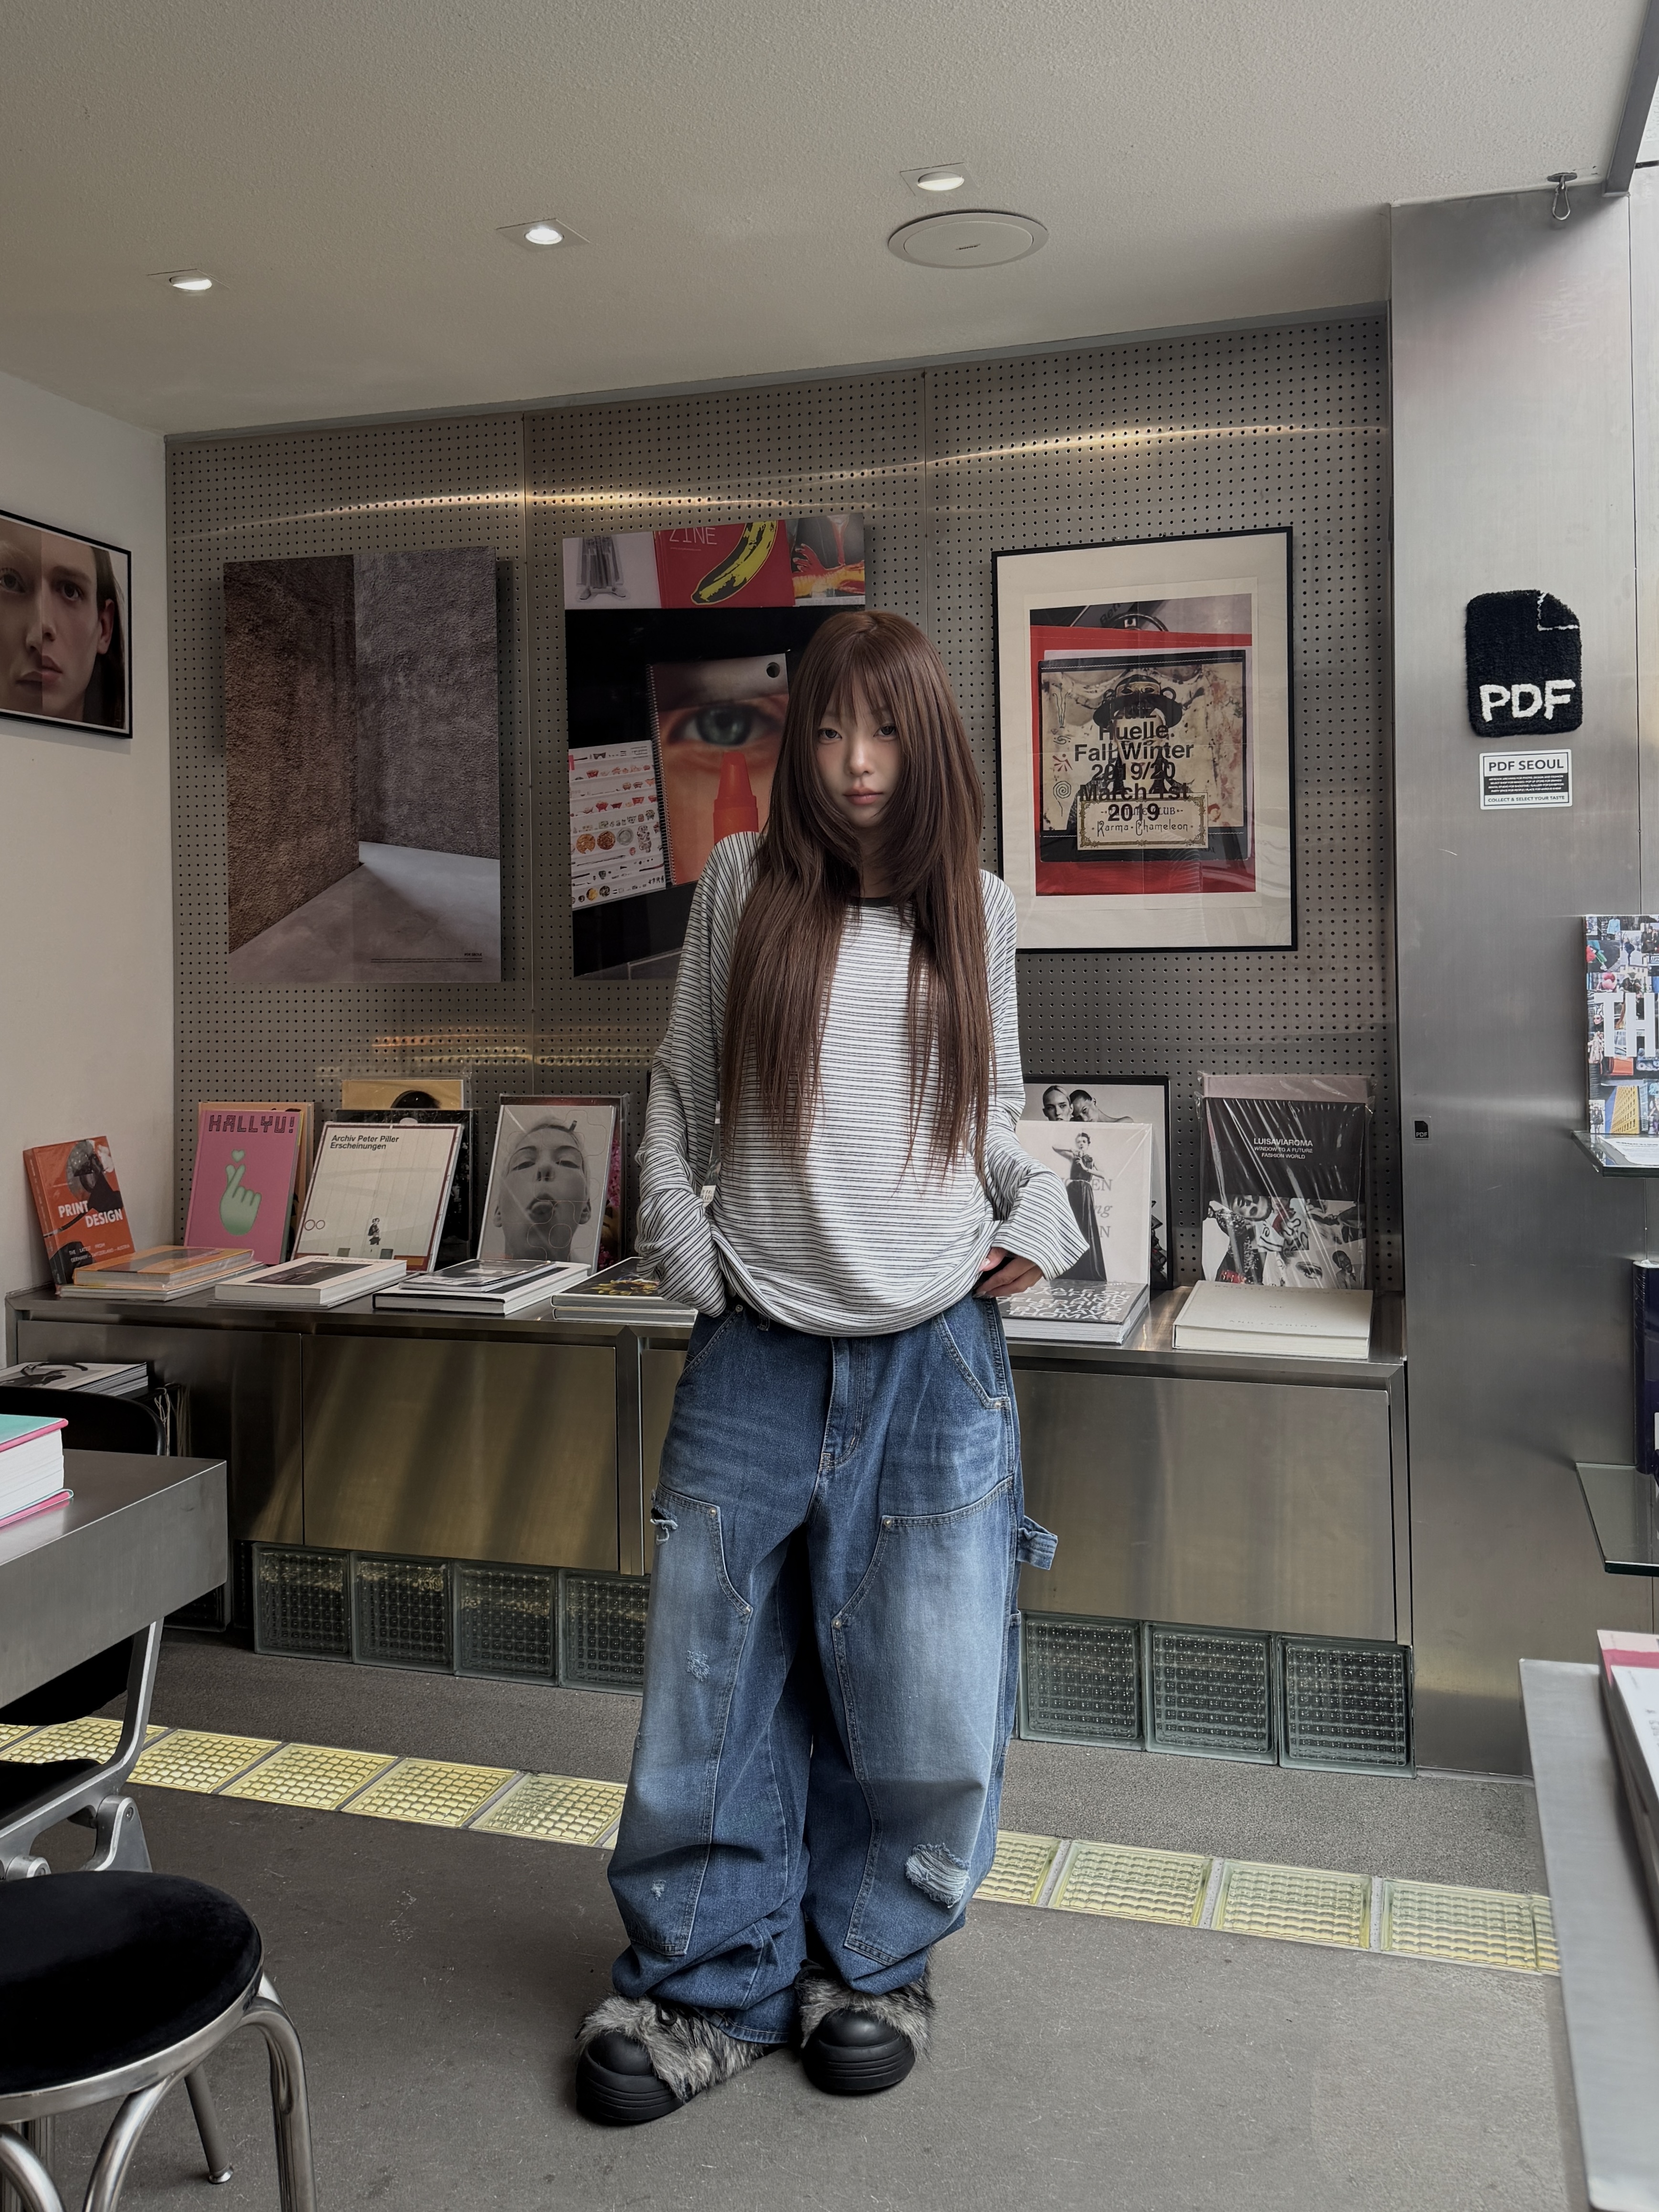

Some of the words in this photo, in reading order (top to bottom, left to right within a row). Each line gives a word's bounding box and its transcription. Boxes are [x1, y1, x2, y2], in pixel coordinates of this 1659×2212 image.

[669, 527, 717, 544] ZINE
[1479, 679, 1576, 722] PDF
[1120, 742, 1194, 760] Winter
[1091, 762, 1176, 782] 2019/20
[1489, 761, 1515, 772] PDF
[1519, 759, 1564, 770] SEOUL
[1079, 783, 1147, 801] March
[1108, 803, 1160, 822] 2019
[1097, 820, 1129, 837] Karma
[1135, 819, 1188, 836] Chameleon
[1594, 992, 1659, 1058] TH
[208, 1115, 295, 1133] HALLYU!
[330, 1142, 387, 1151] Erscheinungen
[1254, 1138, 1313, 1146] LUISAVIAROMA
[58, 1200, 89, 1217] PRINT
[85, 1208, 123, 1228] DESIGN
[1006, 1310, 1116, 1321] THOMAS
